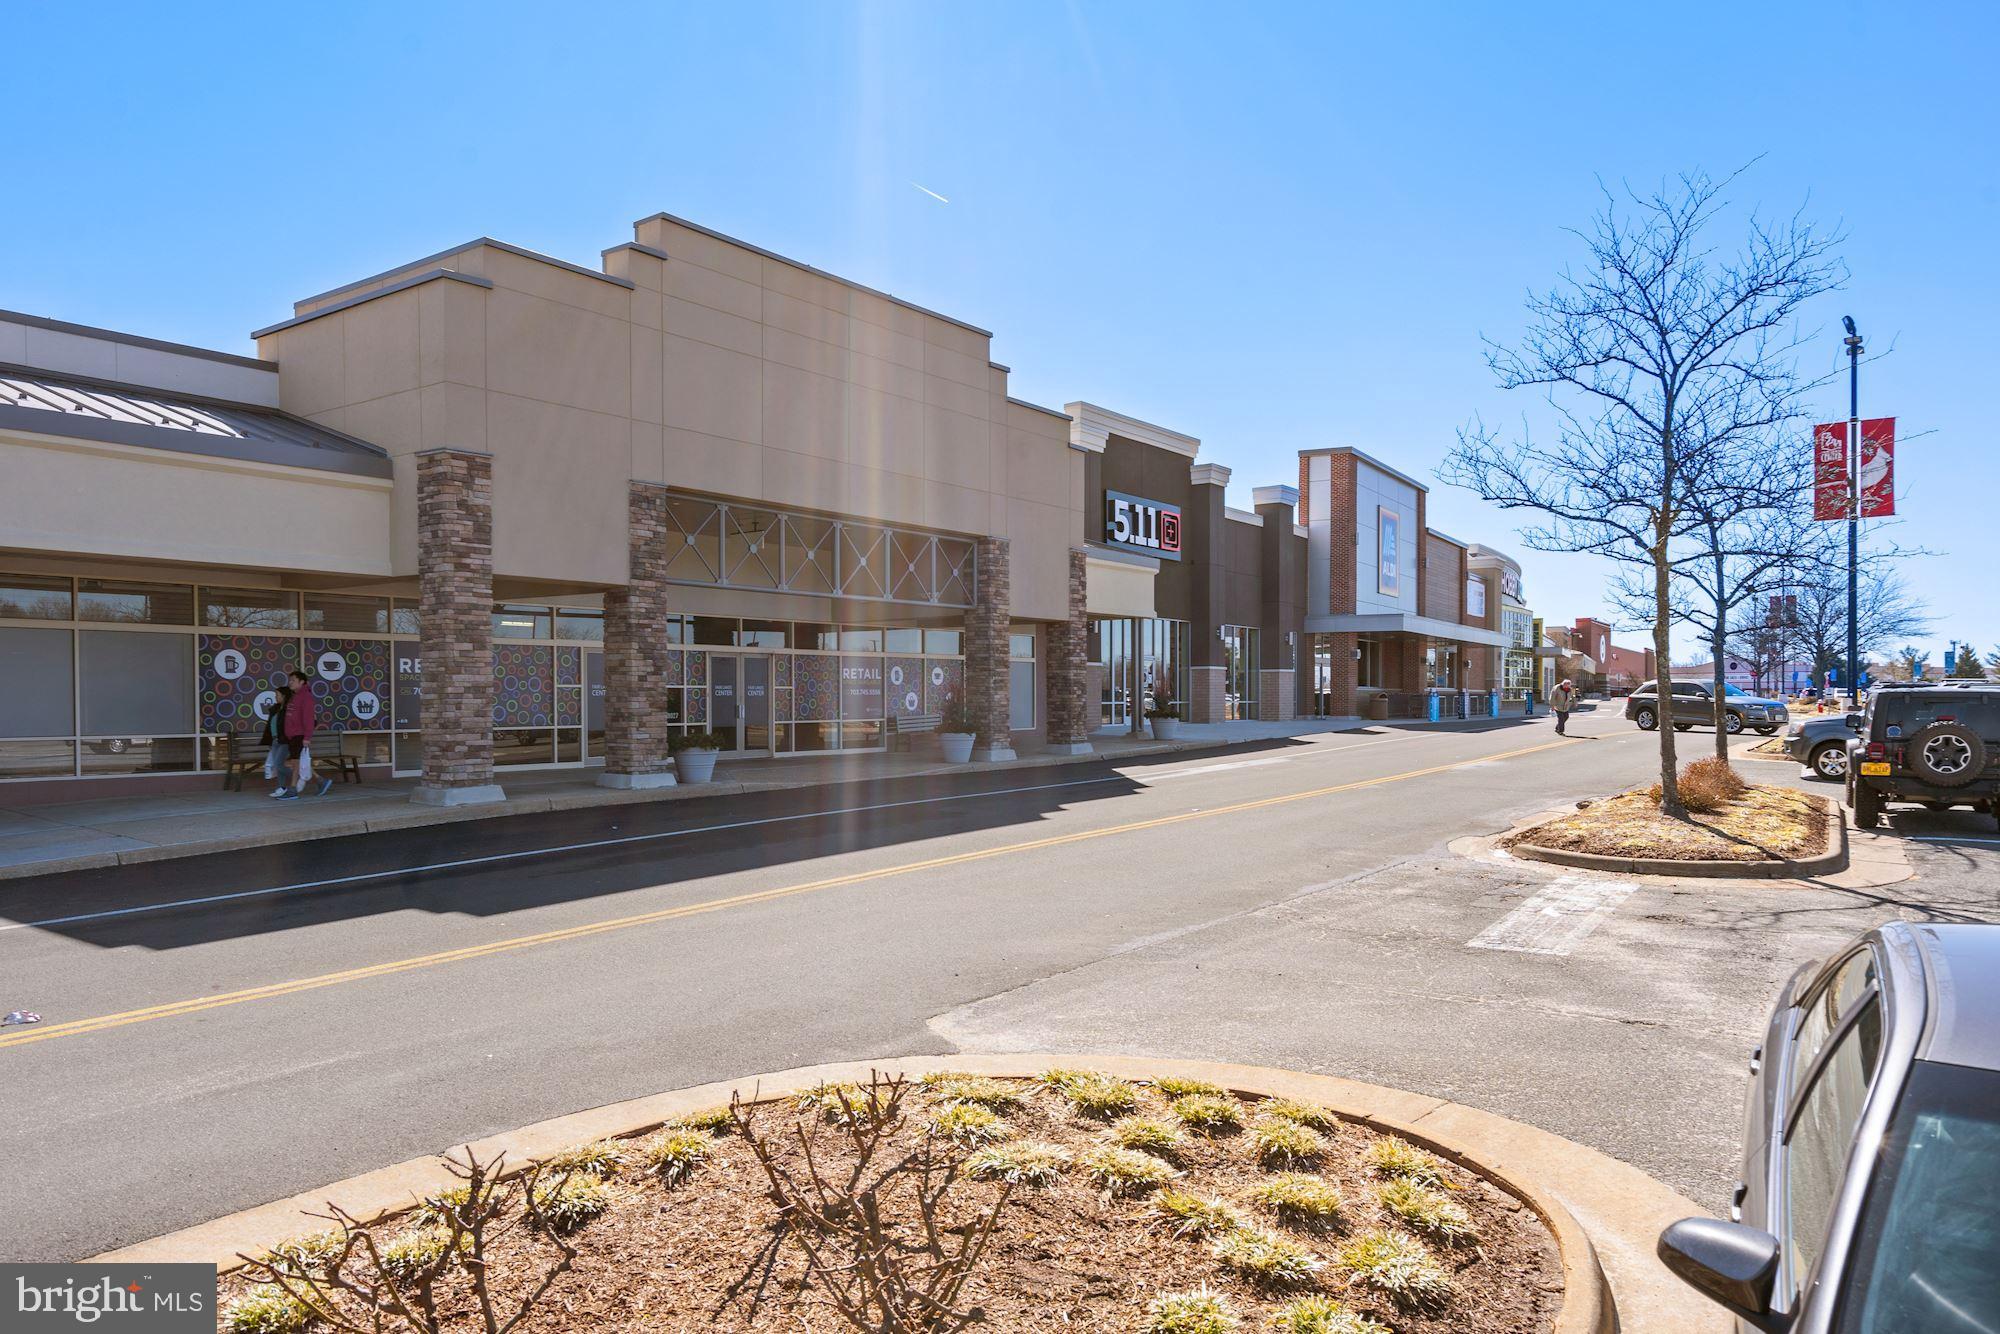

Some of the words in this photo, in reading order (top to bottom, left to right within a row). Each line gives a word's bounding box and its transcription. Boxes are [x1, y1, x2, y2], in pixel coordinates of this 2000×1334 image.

[1114, 499, 1159, 548] 5.11
[1383, 561, 1397, 578] ALDI
[843, 668, 882, 680] RETAIL
